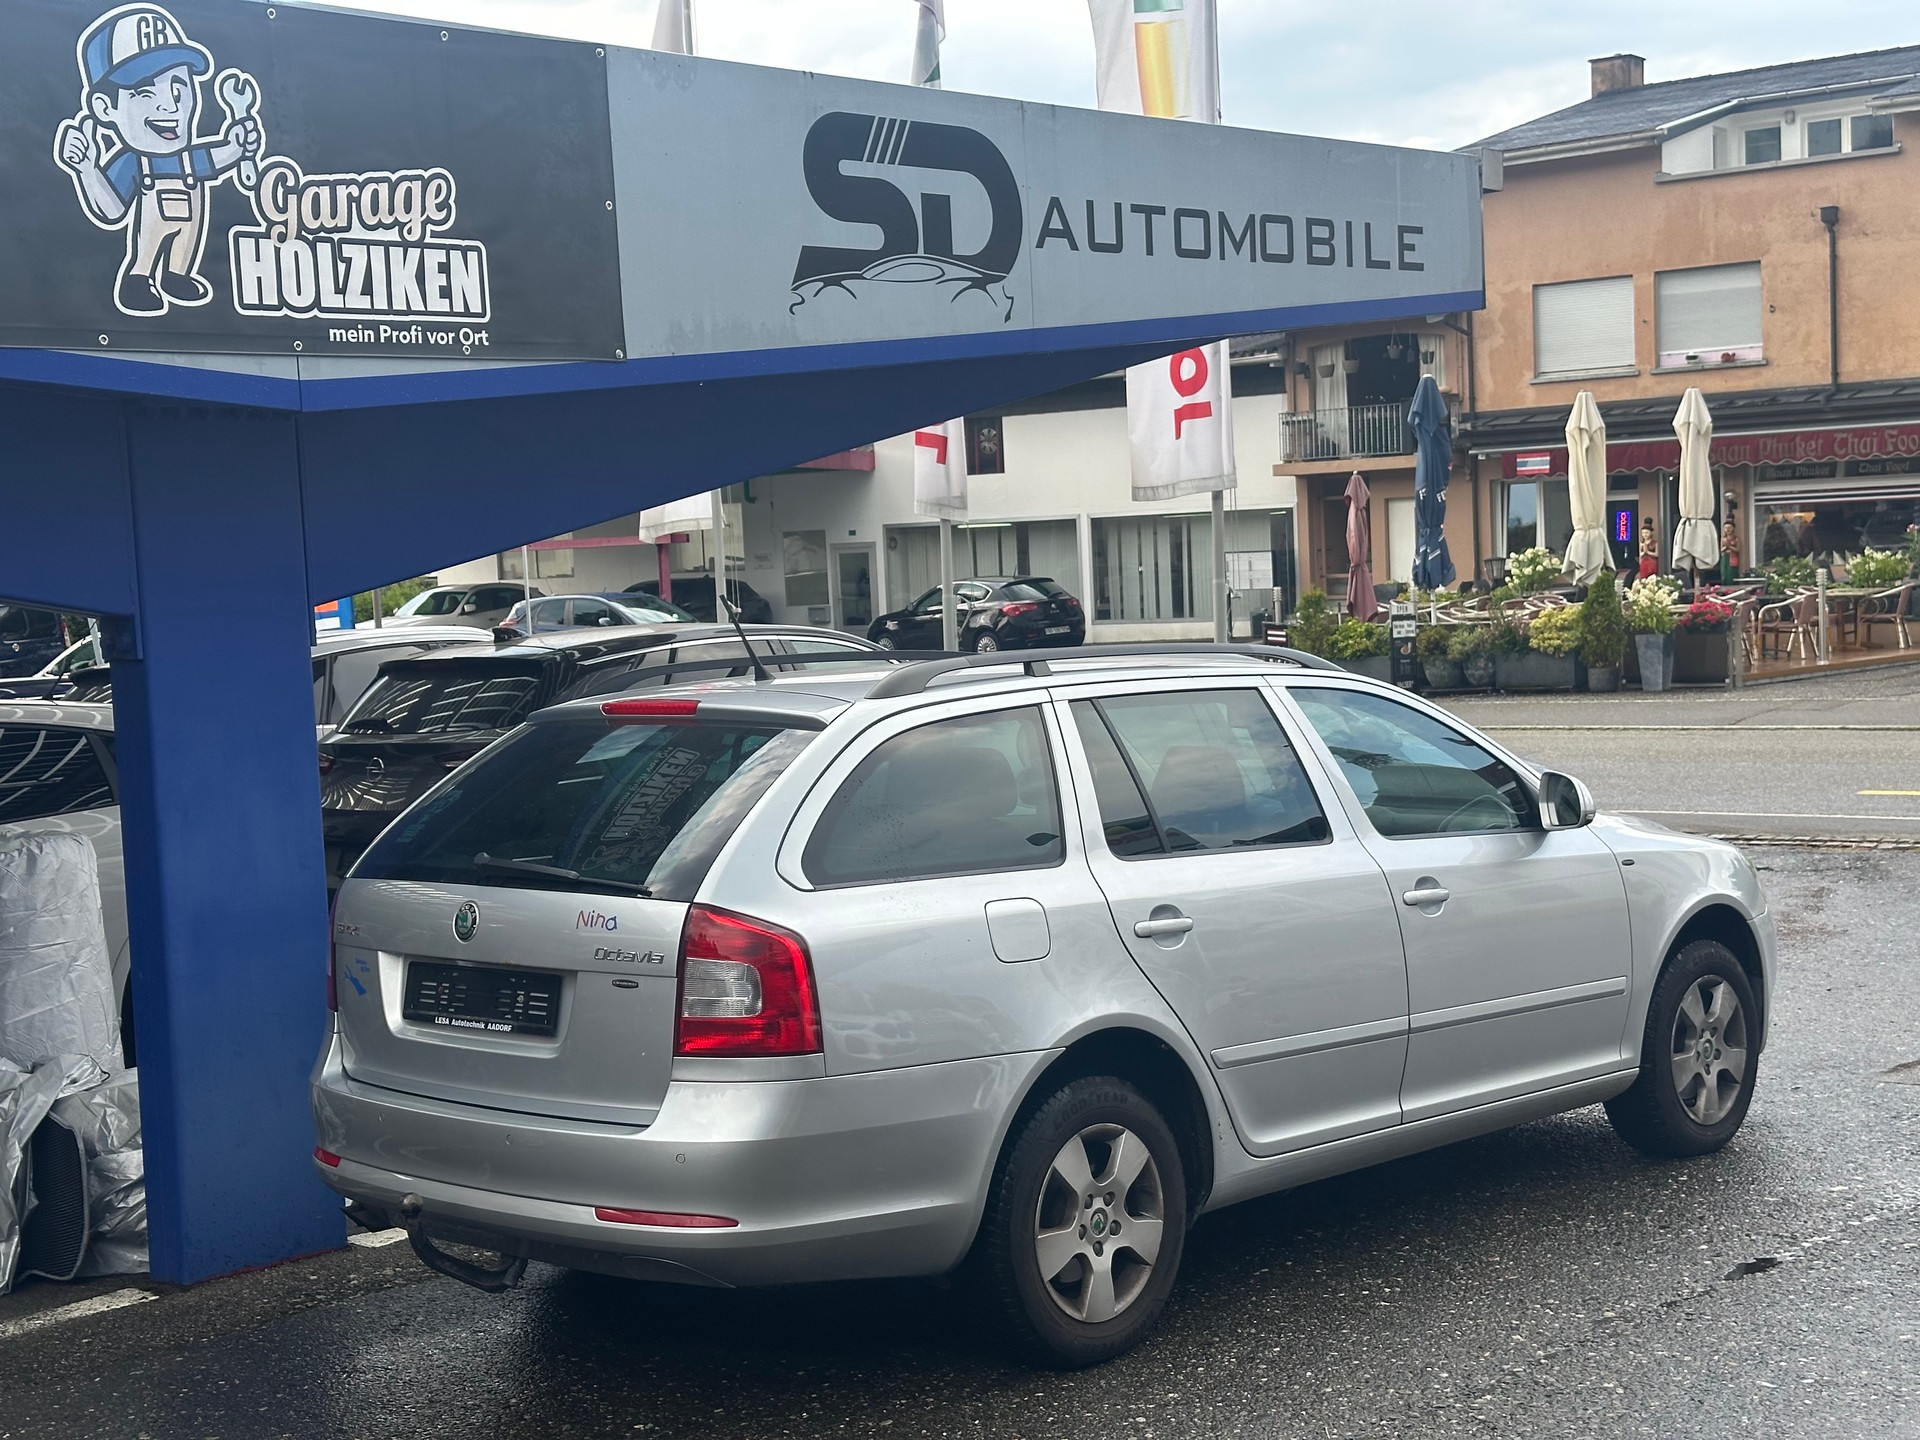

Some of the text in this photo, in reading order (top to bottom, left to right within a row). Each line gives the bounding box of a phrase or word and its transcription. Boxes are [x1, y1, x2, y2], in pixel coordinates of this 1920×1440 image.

[137, 15, 168, 50] GB
[260, 167, 448, 247] Garage
[791, 111, 1023, 287] SD
[1035, 195, 1425, 272] AUTOMOBILE
[238, 237, 483, 313] HOLZIKEN
[328, 324, 490, 346] mein Profi vor Ort
[1758, 434, 1824, 460] Phuket
[1833, 431, 1878, 456] Thai
[1884, 429, 1920, 452] Foo
[1796, 465, 1830, 477] Phuket
[1858, 462, 1882, 473] Thai
[1885, 460, 1910, 471] Food
[1619, 512, 1628, 540] OPEN
[576, 909, 618, 931] Nina
[593, 946, 665, 965] Octavia
[434, 1016, 513, 1032] LESA Autotechnik AADORF
